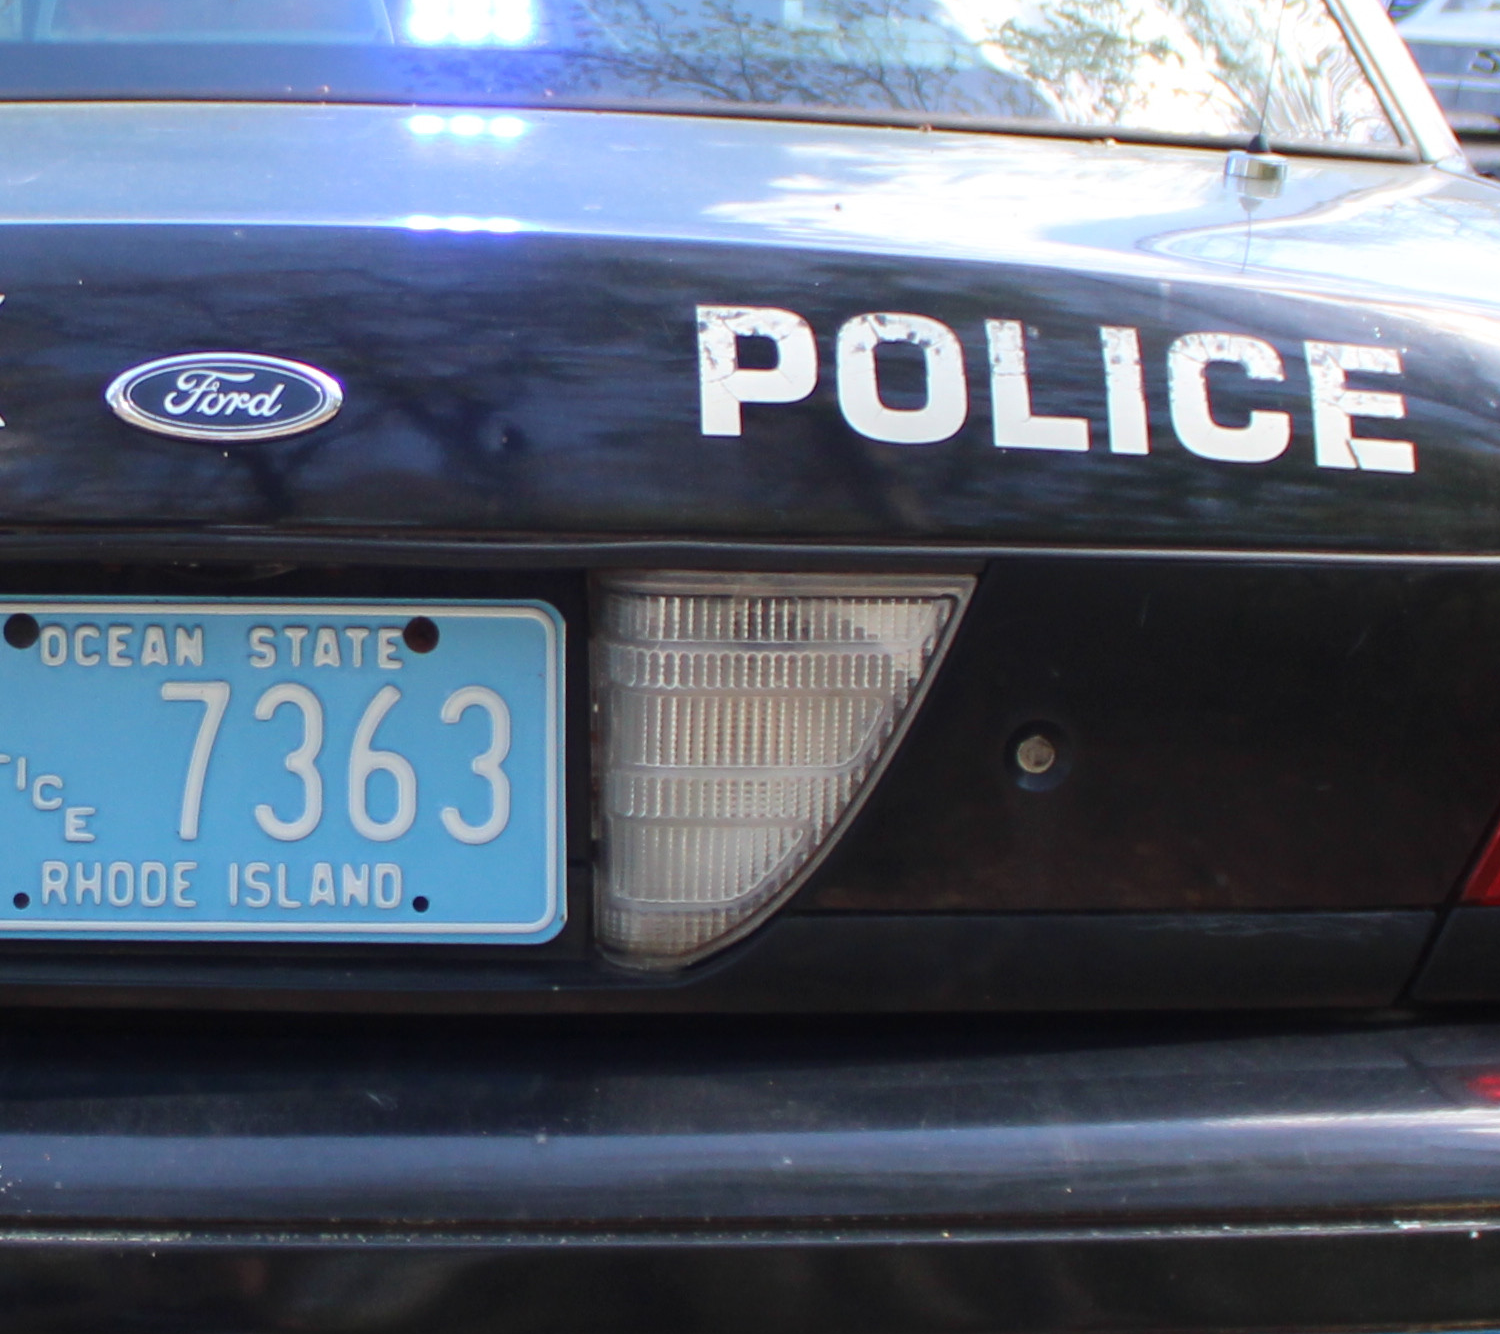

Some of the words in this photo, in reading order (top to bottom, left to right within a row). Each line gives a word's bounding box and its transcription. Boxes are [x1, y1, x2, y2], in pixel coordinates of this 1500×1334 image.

[163, 369, 286, 417] Ford
[696, 304, 1416, 473] POLICE
[39, 624, 204, 667] OCEAN
[249, 626, 405, 670] STATE
[160, 680, 513, 846] 7363
[40, 860, 198, 908] RHODE
[228, 862, 402, 909] ISLAND
